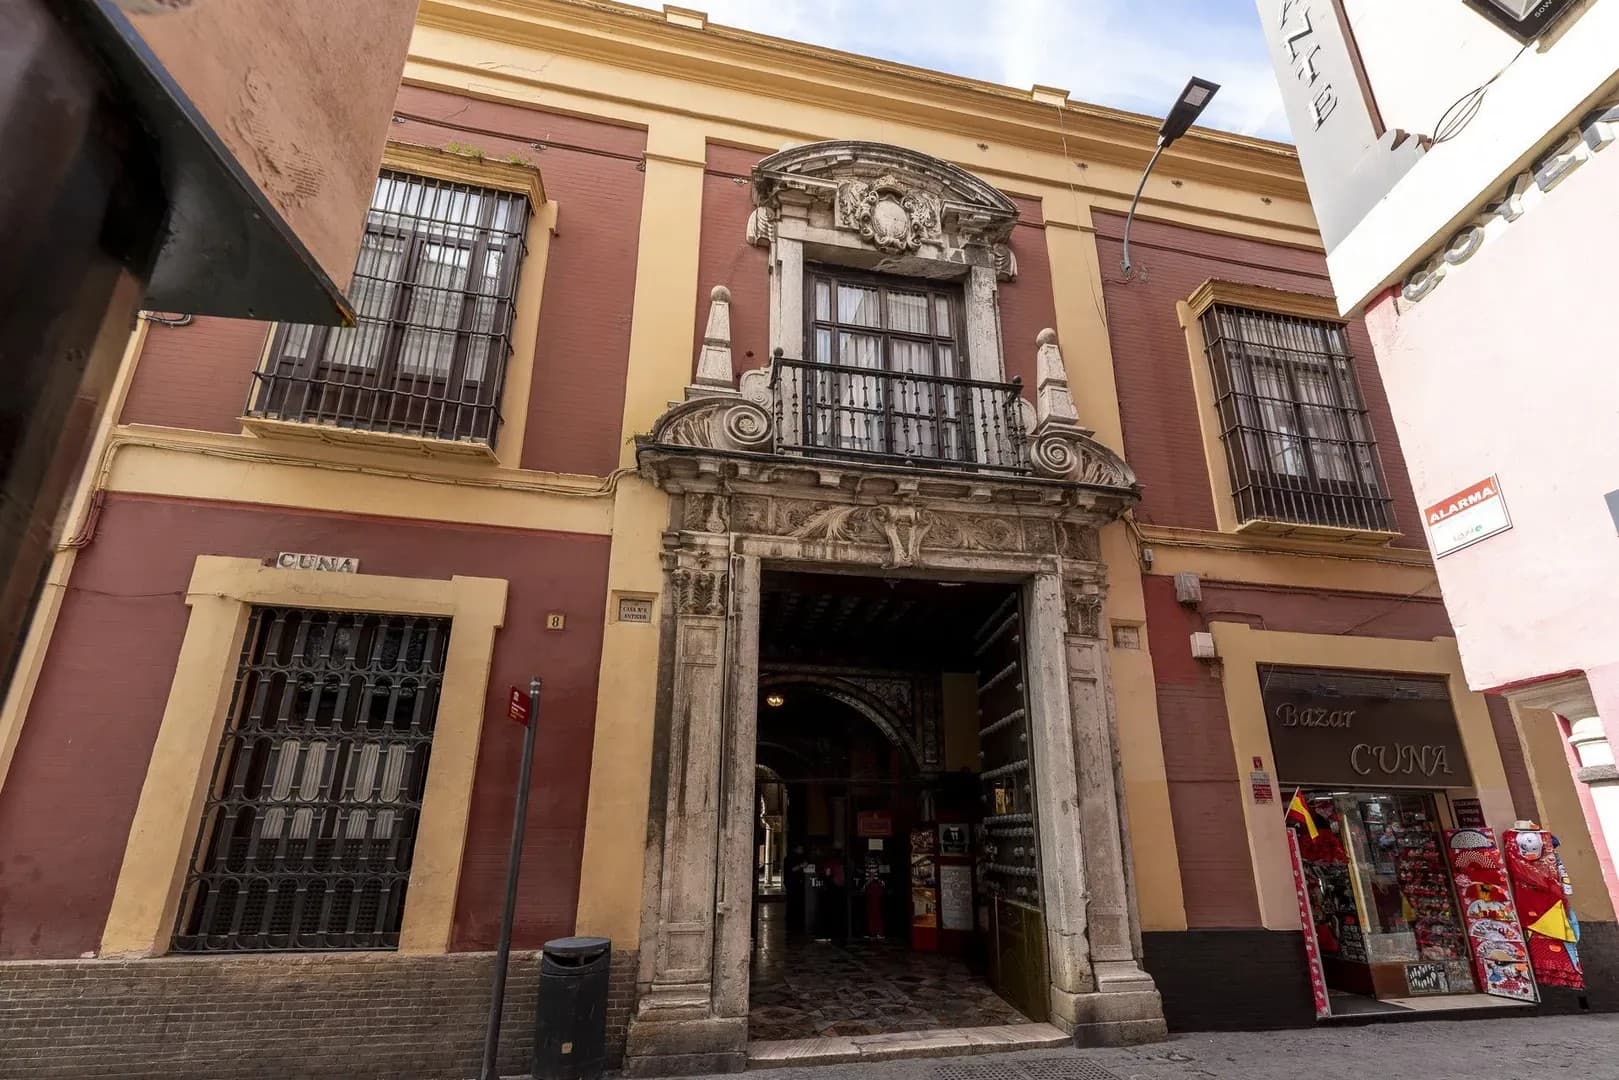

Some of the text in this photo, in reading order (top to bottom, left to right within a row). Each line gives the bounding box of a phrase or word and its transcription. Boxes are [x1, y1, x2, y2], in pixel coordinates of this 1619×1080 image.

[1430, 487, 1494, 523] ALARMA
[279, 553, 353, 572] CUNA
[552, 616, 560, 627] 8
[1276, 702, 1357, 728] Bazar
[1350, 742, 1454, 777] CUNA
